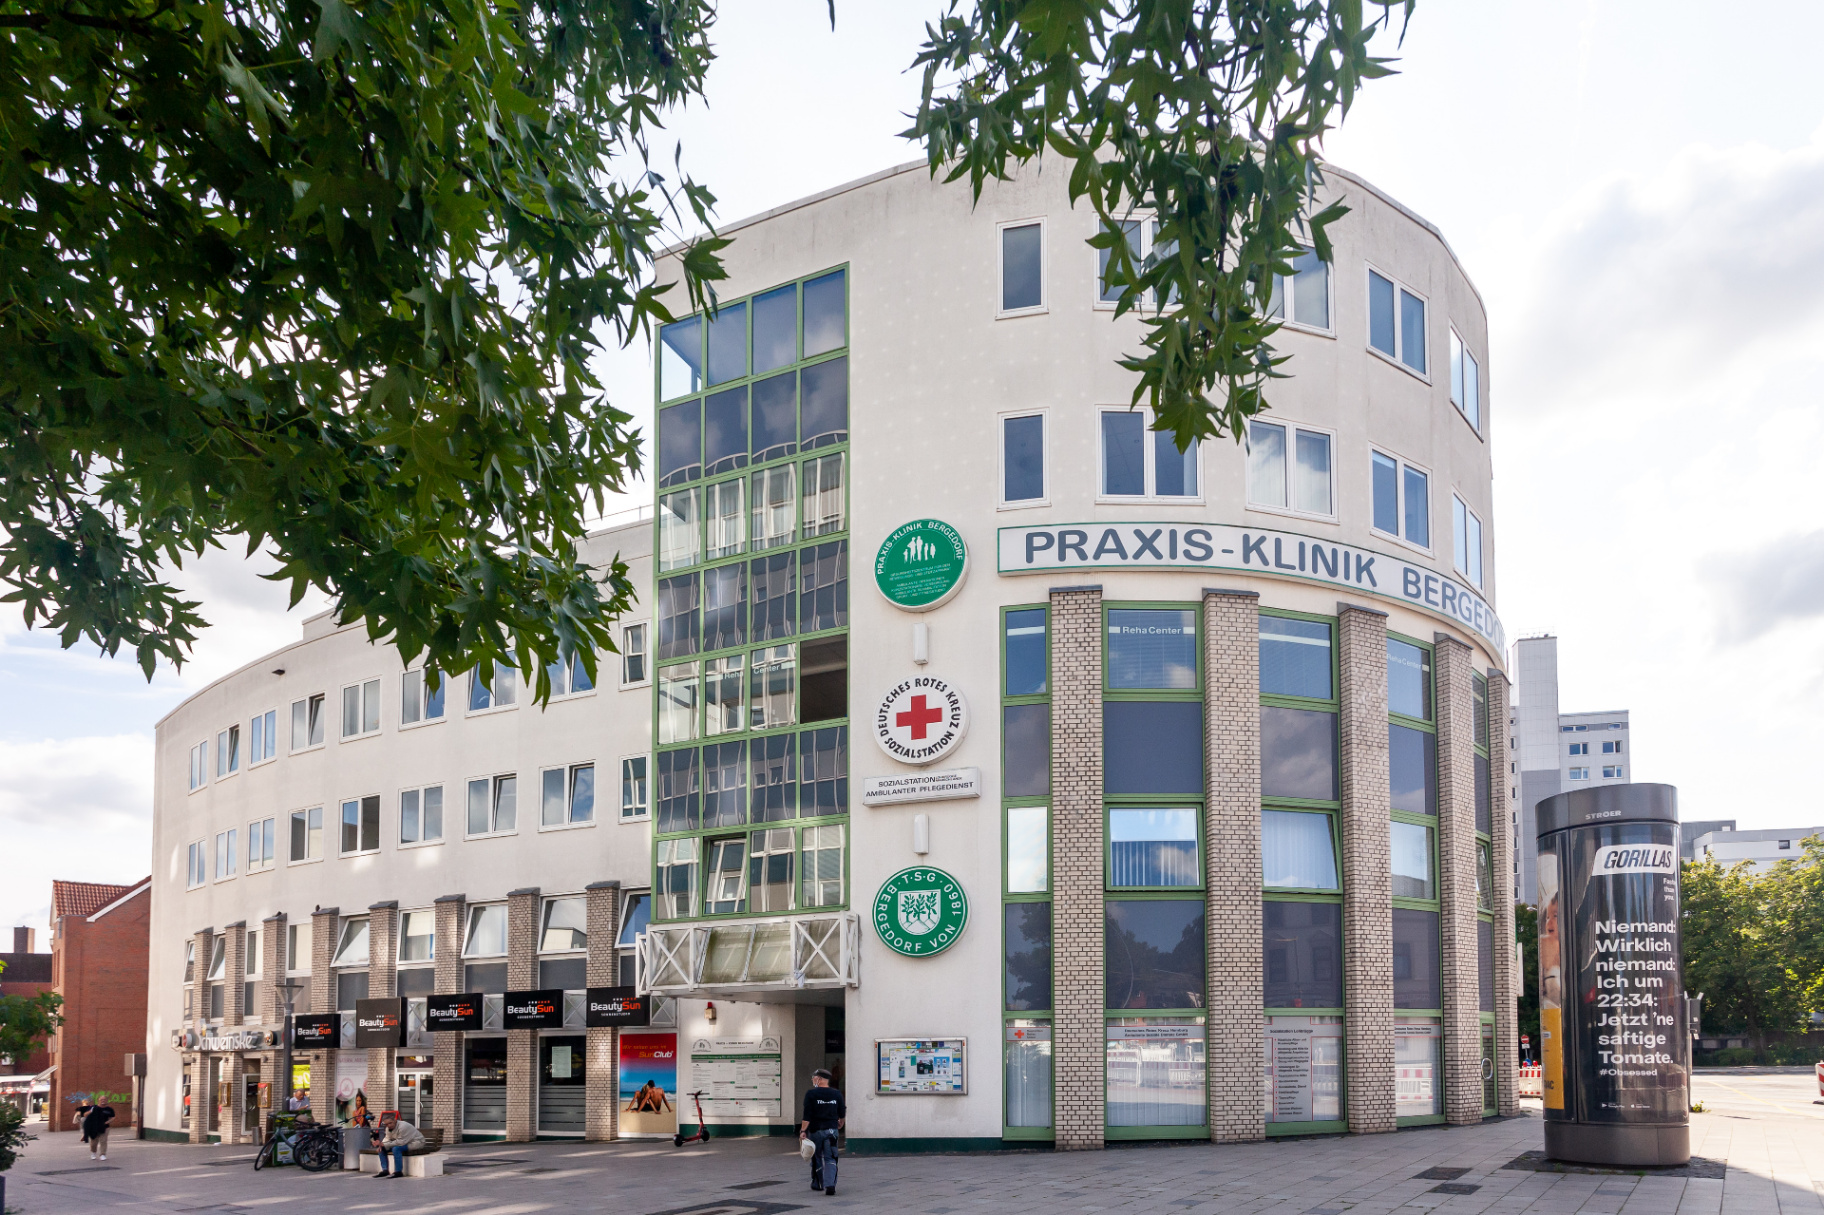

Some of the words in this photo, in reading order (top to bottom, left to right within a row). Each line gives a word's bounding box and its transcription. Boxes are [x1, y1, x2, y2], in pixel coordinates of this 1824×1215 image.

[927, 521, 963, 560] BERGEDORF
[1402, 566, 1505, 660] BERGEDO
[1122, 626, 1148, 635] Reha
[1148, 626, 1182, 635] Center
[724, 670, 744, 680] Reha
[753, 663, 781, 675] Center
[878, 681, 911, 737] DEUTSCHES
[914, 677, 948, 693] ROTES
[945, 691, 961, 729] KREUZ
[884, 730, 955, 758] SOZIALSTATION
[865, 786, 916, 797] AMBULANTER
[919, 781, 974, 792] PFLEGEDIENST
[878, 776, 936, 787] SOZIALSTATION
[1603, 849, 1672, 869] GORILLAS
[877, 884, 922, 952] BERGEDORF
[929, 923, 956, 948] VON
[943, 883, 962, 916] 1860
[1595, 919, 1676, 935] Niemand:
[1595, 937, 1672, 953] Wirklich
[1595, 957, 1676, 972] niemand:
[1597, 974, 1629, 989] Ich
[1634, 977, 1663, 988] um
[590, 1001, 641, 1012] BeautySun
[1597, 993, 1658, 1008] 22:34:
[430, 1007, 474, 1017] BeautySun
[507, 1004, 554, 1014] BeautySun
[359, 1018, 398, 1028] BeautySun
[1597, 1012, 1648, 1027] Jetzt
[297, 1026, 332, 1037] BeautySun
[1598, 1030, 1666, 1048] saftige
[1598, 1050, 1674, 1064] Tomate.
[1599, 1068, 1658, 1076] #Obsessed
